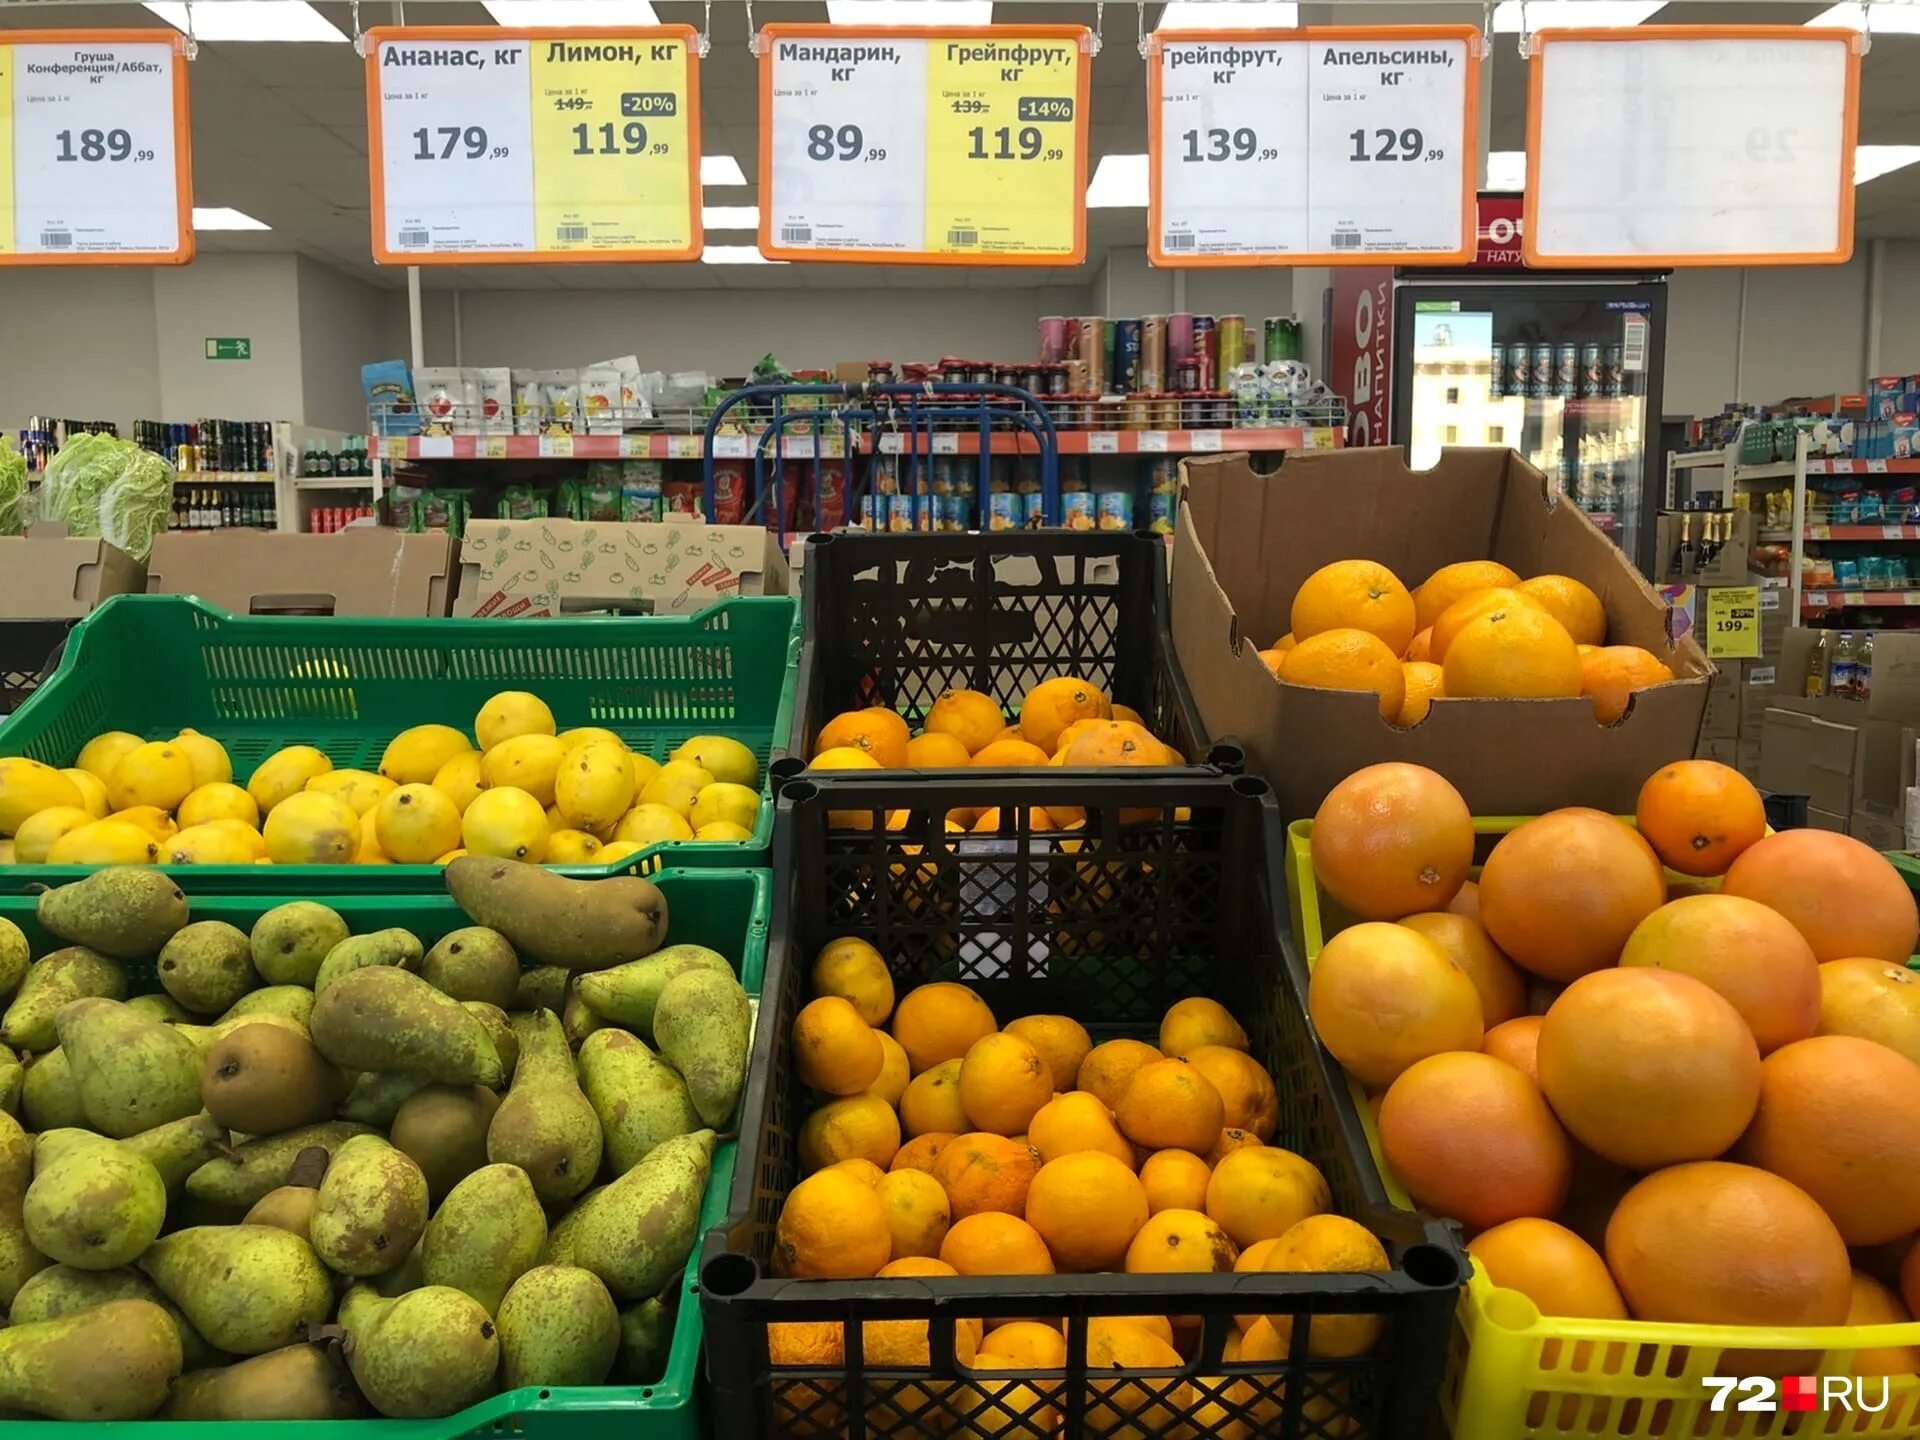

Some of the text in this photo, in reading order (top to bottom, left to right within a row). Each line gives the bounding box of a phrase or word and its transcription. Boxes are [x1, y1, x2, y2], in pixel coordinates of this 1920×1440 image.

[74, 51, 115, 63] Груша
[384, 46, 522, 69] Ананас, кг
[547, 42, 678, 65] Лимон, кг
[780, 44, 900, 65] Мандарин,
[948, 43, 1071, 66] Грейпфрут,
[1324, 48, 1453, 67] Апельсины,
[28, 62, 162, 75] Конференция/Аббат,
[832, 68, 855, 81] кг
[1001, 69, 1023, 81] кг
[89, 74, 104, 84] кг
[1214, 67, 1236, 84] кг
[1381, 72, 1404, 85] кг
[624, 98, 673, 110] -20%
[1021, 102, 1070, 116] -14%
[1374, 281, 1387, 444] НАПИТКИ
[1717, 620, 1743, 631] 199
